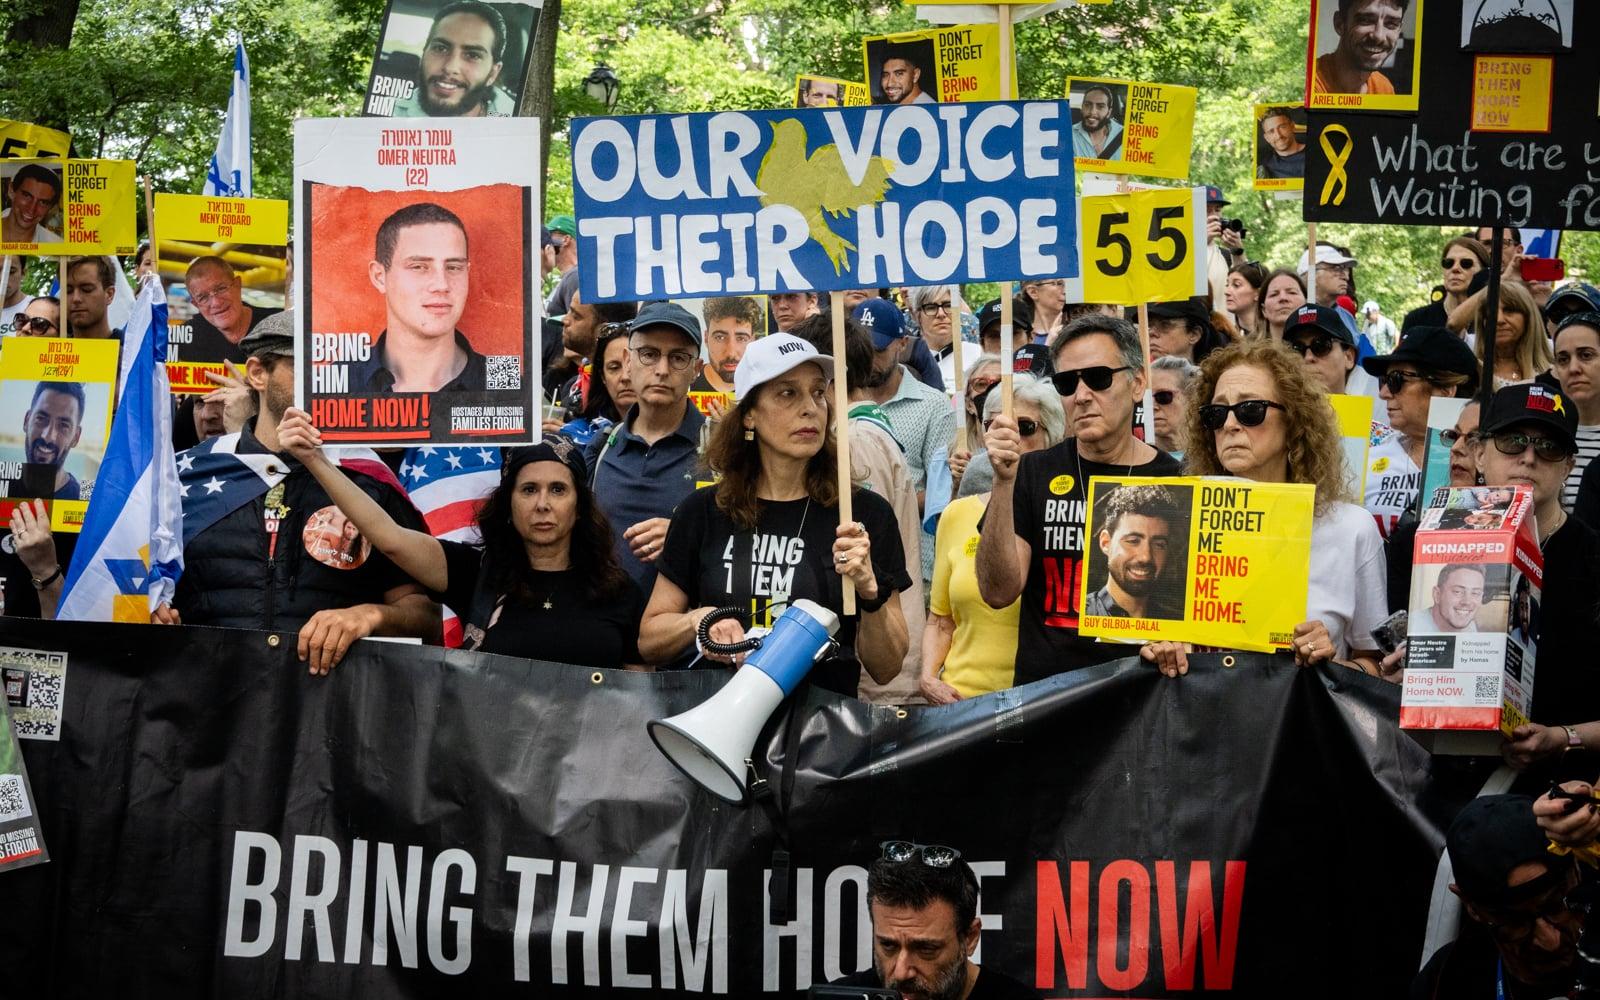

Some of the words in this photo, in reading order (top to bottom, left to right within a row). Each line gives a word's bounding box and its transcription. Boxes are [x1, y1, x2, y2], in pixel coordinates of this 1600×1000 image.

[939, 30, 972, 47] DON'T
[941, 45, 982, 62] FORGET
[942, 63, 958, 78] ME
[1478, 62, 1532, 75] BRING
[372, 75, 414, 100] BRING
[849, 86, 866, 98] DON
[943, 76, 978, 94] BRING
[1478, 78, 1520, 91] THEM
[1132, 86, 1162, 100] DON'T
[1314, 96, 1335, 105] ARIEL
[1338, 96, 1362, 106] CUNIO
[368, 95, 396, 117] HIM
[1131, 99, 1168, 114] FORGET
[1130, 112, 1144, 124] ME
[382, 130, 422, 146] נאוטרה
[425, 130, 452, 146] עומר
[1128, 124, 1158, 138] BRING
[1126, 137, 1142, 150] ME
[1372, 123, 1478, 173] What
[1500, 142, 1566, 170] are
[378, 149, 409, 166] OMER
[412, 149, 456, 166] NEUTRA
[576, 112, 767, 202] OUR
[824, 103, 1060, 187] VOICE
[1125, 150, 1156, 164] HOME.
[68, 164, 98, 176] DON'T
[406, 168, 428, 186] (22)
[68, 178, 108, 190] FORGET
[69, 190, 84, 202] ME
[1370, 176, 1532, 228] Waiting
[70, 204, 101, 216] BRING
[70, 217, 84, 230] ME
[200, 212, 220, 224] MENY
[222, 214, 252, 226] GODARD
[70, 230, 102, 244] HOME.
[218, 225, 232, 238] (73)
[579, 204, 814, 299] THEIR
[857, 196, 1059, 284] HOPE
[860, 308, 875, 326] LA
[168, 325, 193, 344] RING
[312, 332, 372, 362] BRING
[778, 342, 805, 356] NOW
[39, 354, 52, 364] GALI
[54, 354, 80, 364] BERMAN
[312, 364, 350, 394] HIM
[312, 398, 368, 429] HOME
[373, 394, 430, 429] NOW!
[452, 406, 482, 416] HOSTAGES
[483, 406, 496, 416] AND
[496, 406, 524, 416] MISSING
[452, 416, 490, 430] FAMILIES
[492, 416, 524, 430] FORUM
[0, 462, 22, 480] RING
[1380, 472, 1422, 490] BRIN
[1201, 486, 1252, 509] DON'T
[1044, 500, 1087, 524] BRIN
[1200, 510, 1265, 532] FORGET
[1198, 532, 1223, 554] ME
[1422, 543, 1504, 554] KIDNAPPED
[1196, 554, 1248, 578] BRING
[1194, 578, 1220, 599] ME
[1192, 600, 1246, 624] HOME.
[1084, 617, 1100, 628] GUY
[1102, 618, 1160, 632] GILBOA-DALAL
[1408, 676, 1433, 686] Bring
[1436, 676, 1456, 684] Him
[1406, 688, 1434, 696] Home
[1436, 688, 1465, 696] NOW.
[8, 837, 40, 857] FORUM
[224, 830, 476, 975] BRING
[506, 855, 728, 994] THEM
[763, 860, 1006, 991] HOE
[1036, 861, 1248, 991] NOW
